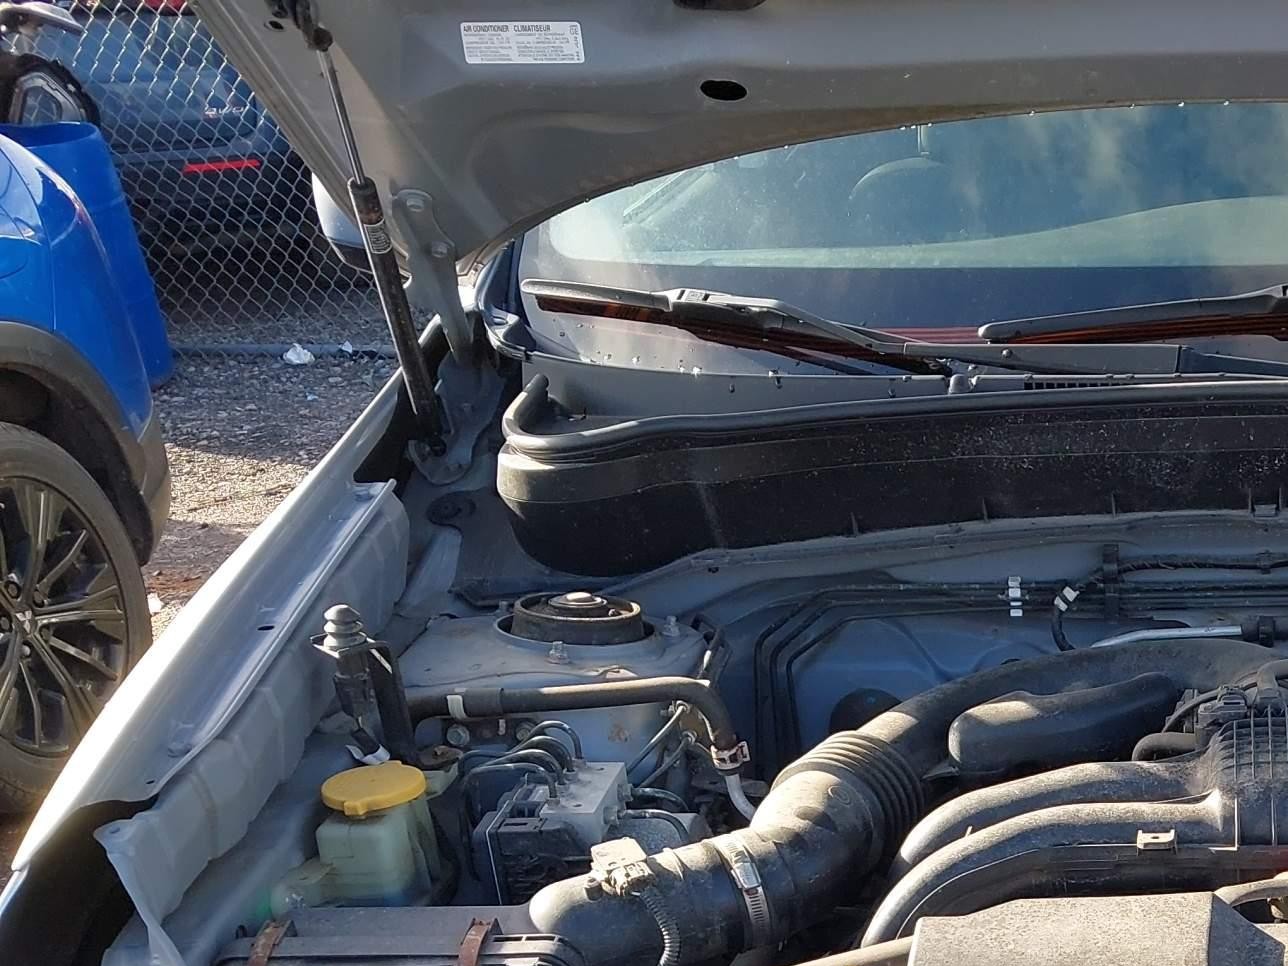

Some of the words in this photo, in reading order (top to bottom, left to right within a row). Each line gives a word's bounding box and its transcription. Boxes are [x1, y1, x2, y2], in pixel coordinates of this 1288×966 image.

[463, 24, 471, 32] AIR
[472, 24, 509, 32] CONDITIONER
[513, 24, 551, 32] CLIMATISEUR
